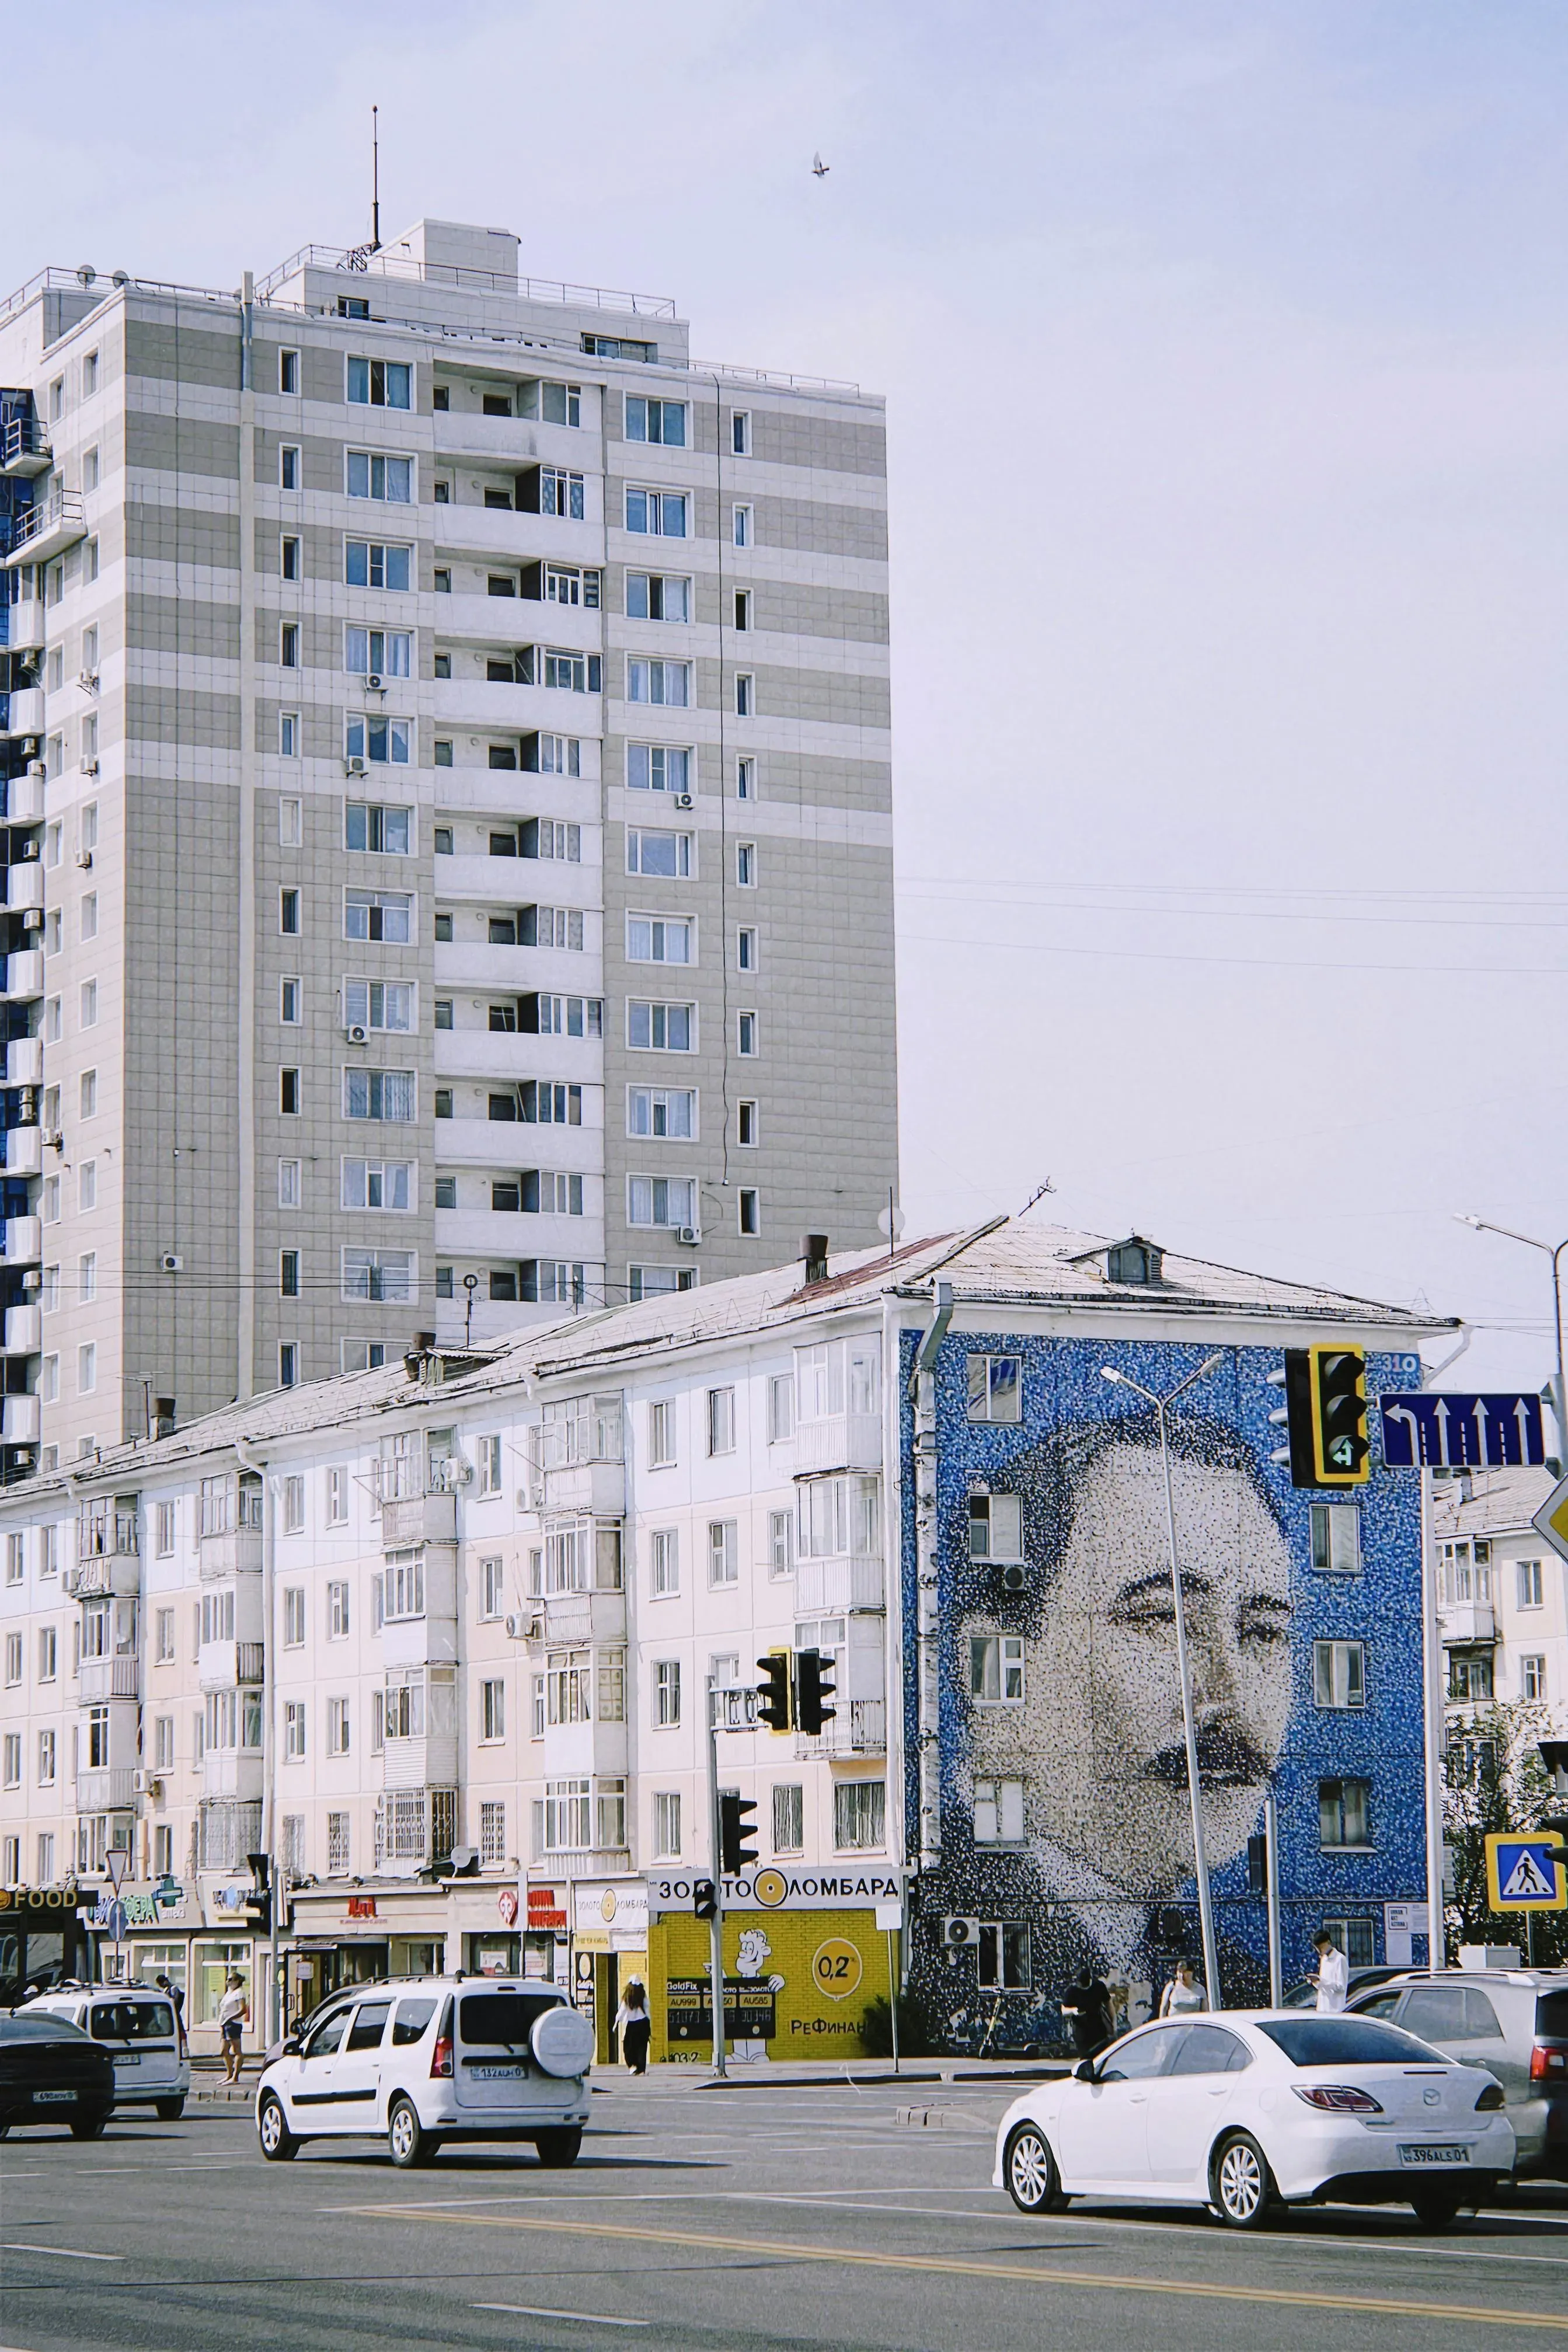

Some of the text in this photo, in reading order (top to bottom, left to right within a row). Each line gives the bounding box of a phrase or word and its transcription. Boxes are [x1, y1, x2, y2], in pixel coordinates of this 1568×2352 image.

[1382, 1354, 1417, 1372] 310
[659, 1878, 898, 1898] ЗОТО ЛОМБАРД
[15, 1890, 77, 1908] FOOD
[579, 1899, 647, 1911] ЗОЛОТО ЛОМБАРД
[667, 1981, 697, 1991] GoldFix
[671, 1998, 696, 2006] AU999
[744, 1996, 768, 2005] AU585
